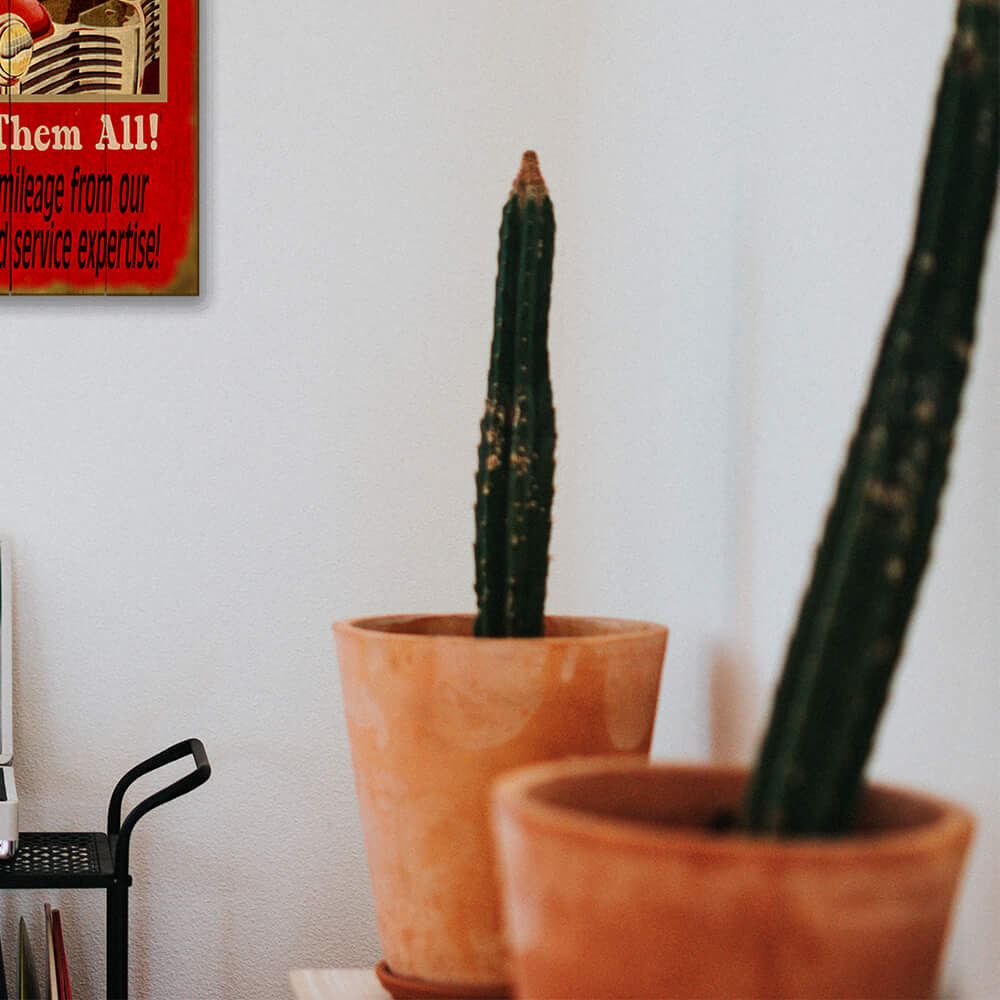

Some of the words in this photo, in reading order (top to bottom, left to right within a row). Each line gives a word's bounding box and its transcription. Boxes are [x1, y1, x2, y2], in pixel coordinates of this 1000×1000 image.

[95, 113, 160, 151] All!
[70, 165, 113, 213] from
[119, 172, 150, 213] our
[13, 222, 73, 269] service
[77, 222, 161, 278] expertise!
